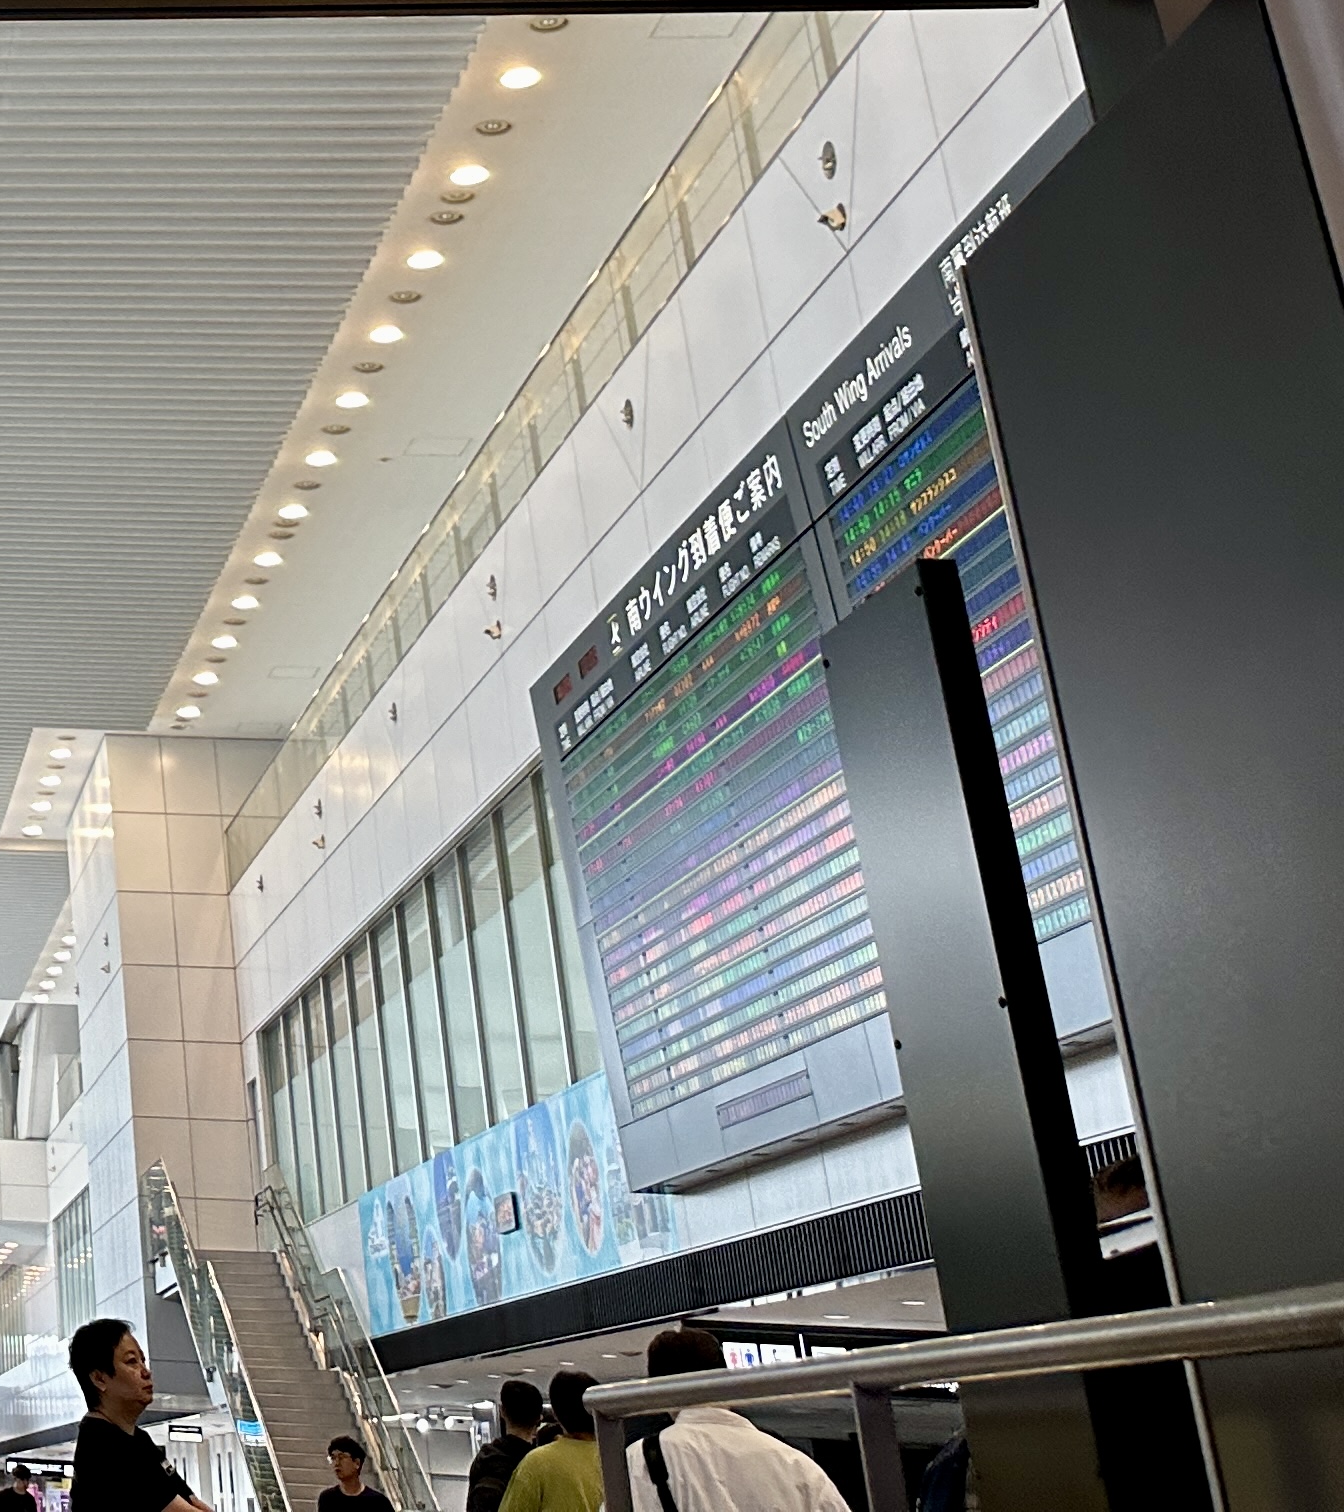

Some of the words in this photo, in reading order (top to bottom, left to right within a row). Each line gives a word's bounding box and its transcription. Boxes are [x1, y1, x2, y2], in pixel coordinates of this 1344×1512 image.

[802, 401, 838, 448] South
[833, 373, 868, 421] Wing
[865, 325, 912, 386] Arrivals
[625, 454, 783, 636] 南ウイング到着便ご案内
